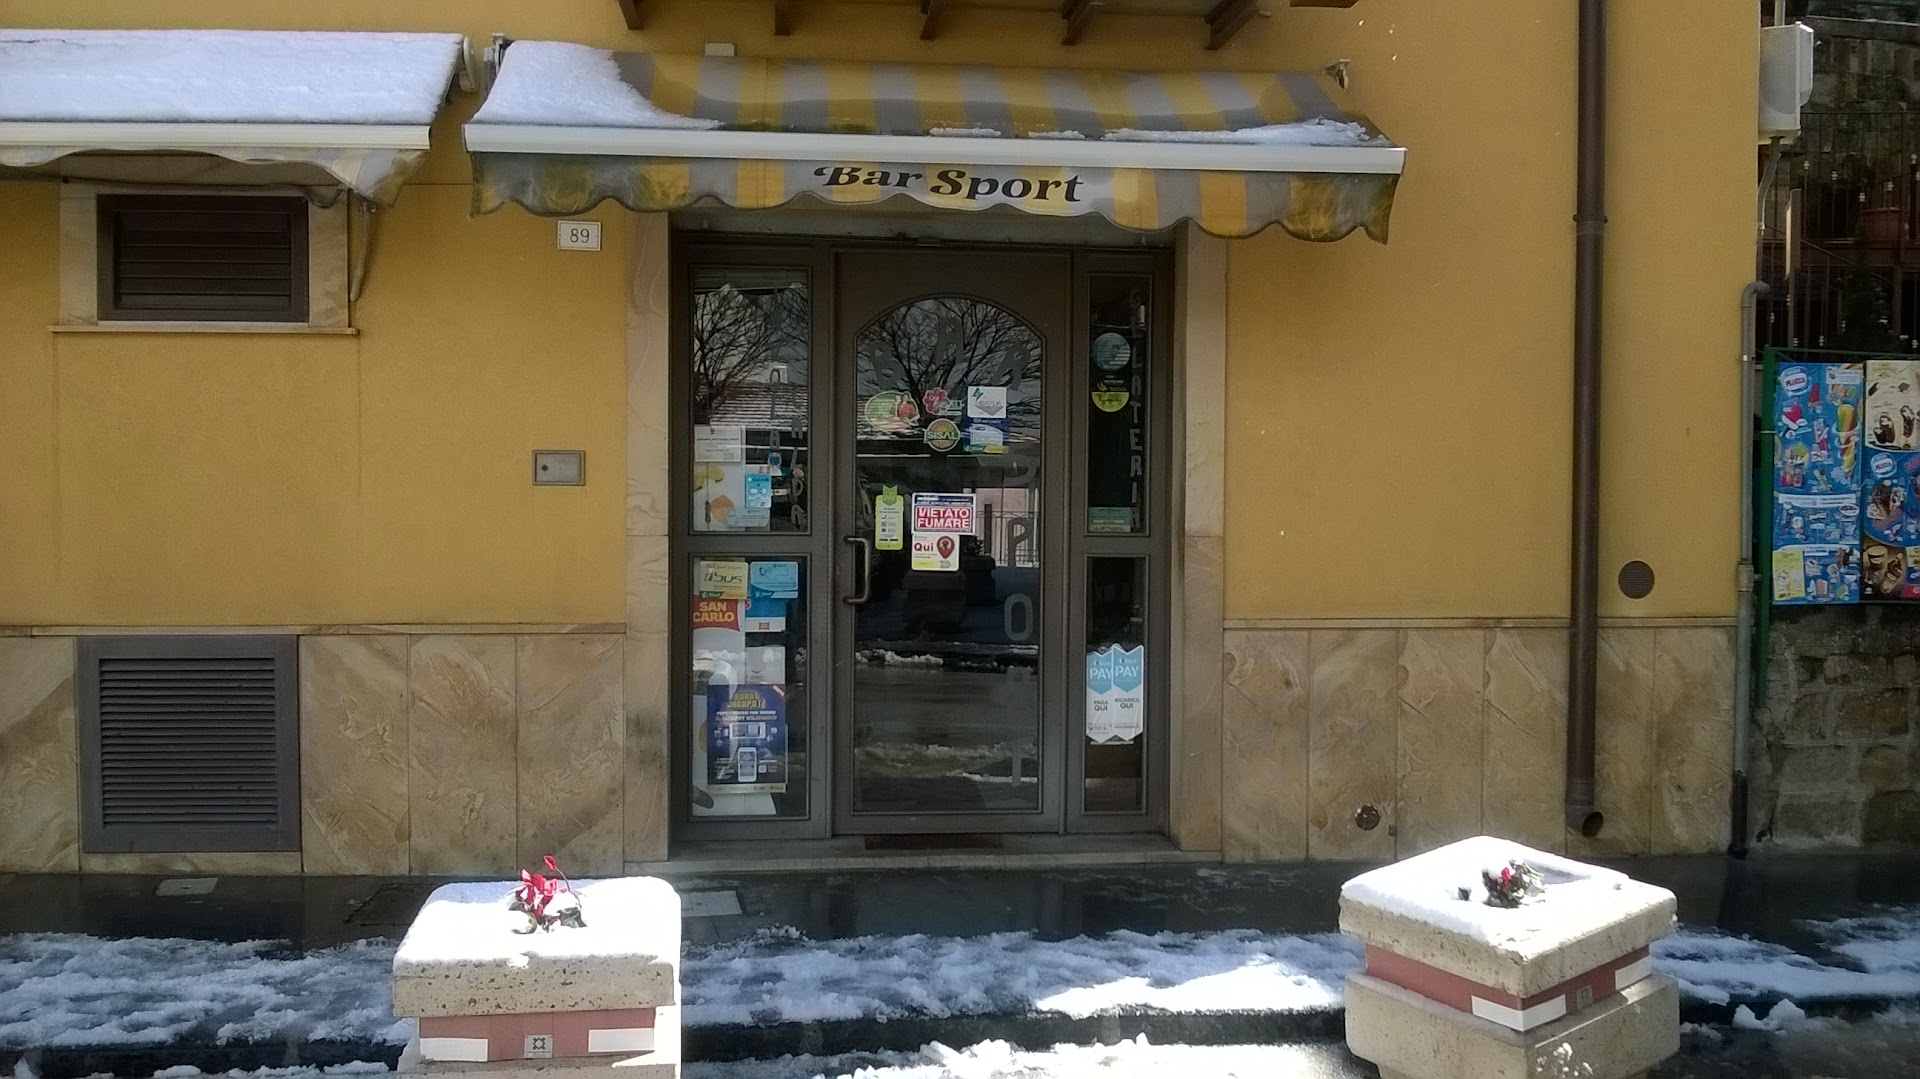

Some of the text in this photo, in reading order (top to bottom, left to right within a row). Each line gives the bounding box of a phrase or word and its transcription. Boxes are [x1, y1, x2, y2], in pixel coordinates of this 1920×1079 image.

[813, 166, 1084, 202] Bar Sport
[570, 228, 590, 243] 89
[926, 431, 958, 440] SISAL
[918, 507, 969, 519] VIETATO
[917, 518, 970, 529] FUMARE
[913, 542, 934, 552] Qui
[699, 601, 727, 612] SAN
[692, 611, 736, 623] CARLO
[1089, 667, 1114, 680] PAY
[1115, 664, 1140, 678] PAY
[1093, 704, 1108, 712] QUI
